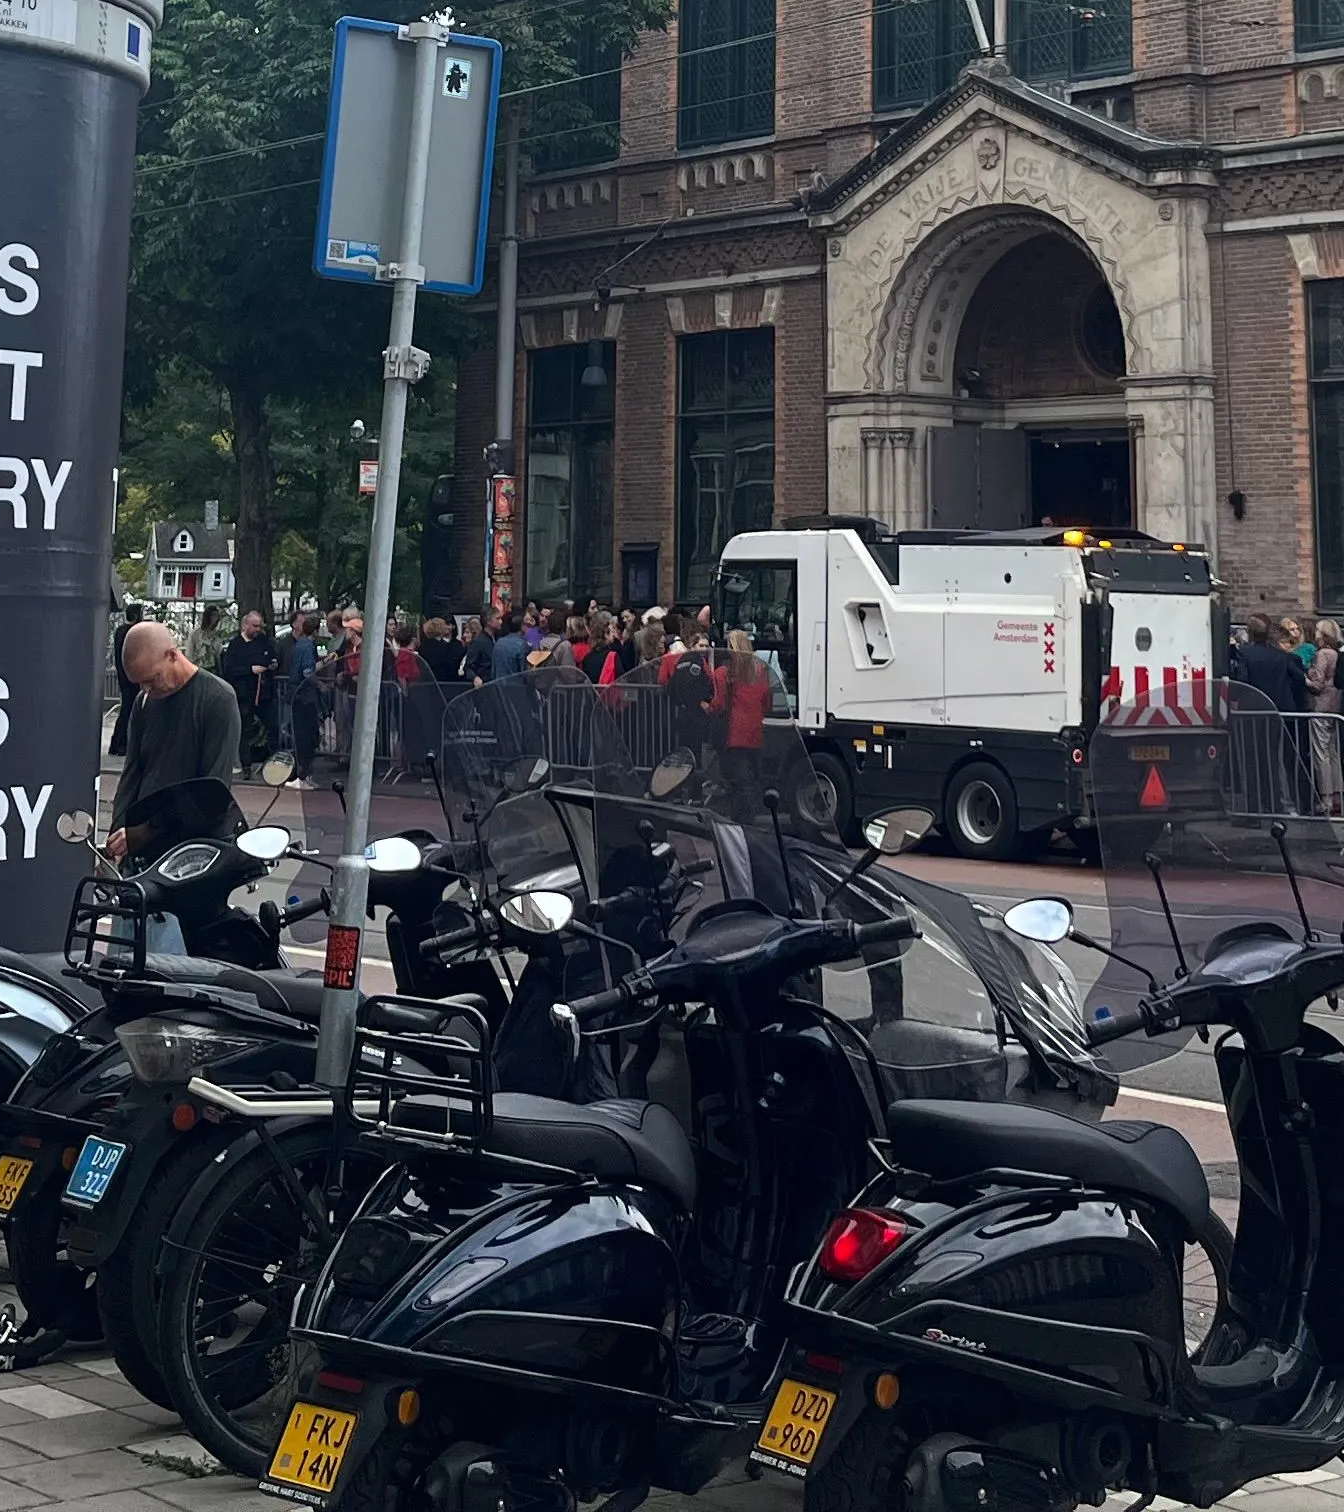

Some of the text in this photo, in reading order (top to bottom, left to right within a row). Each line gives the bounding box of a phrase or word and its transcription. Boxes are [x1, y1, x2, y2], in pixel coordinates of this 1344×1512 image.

[994, 632, 1039, 643] Amsterdam
[997, 620, 1038, 631] Gemeente
[91, 1145, 119, 1170] DJP
[5, 1161, 29, 1184] FKF
[80, 1171, 108, 1196] 32Z
[922, 1328, 987, 1353] Sprint
[791, 1390, 829, 1423] DZD
[306, 1413, 350, 1448] FKJ
[779, 1423, 816, 1456] 96D
[296, 1449, 339, 1486] 14N
